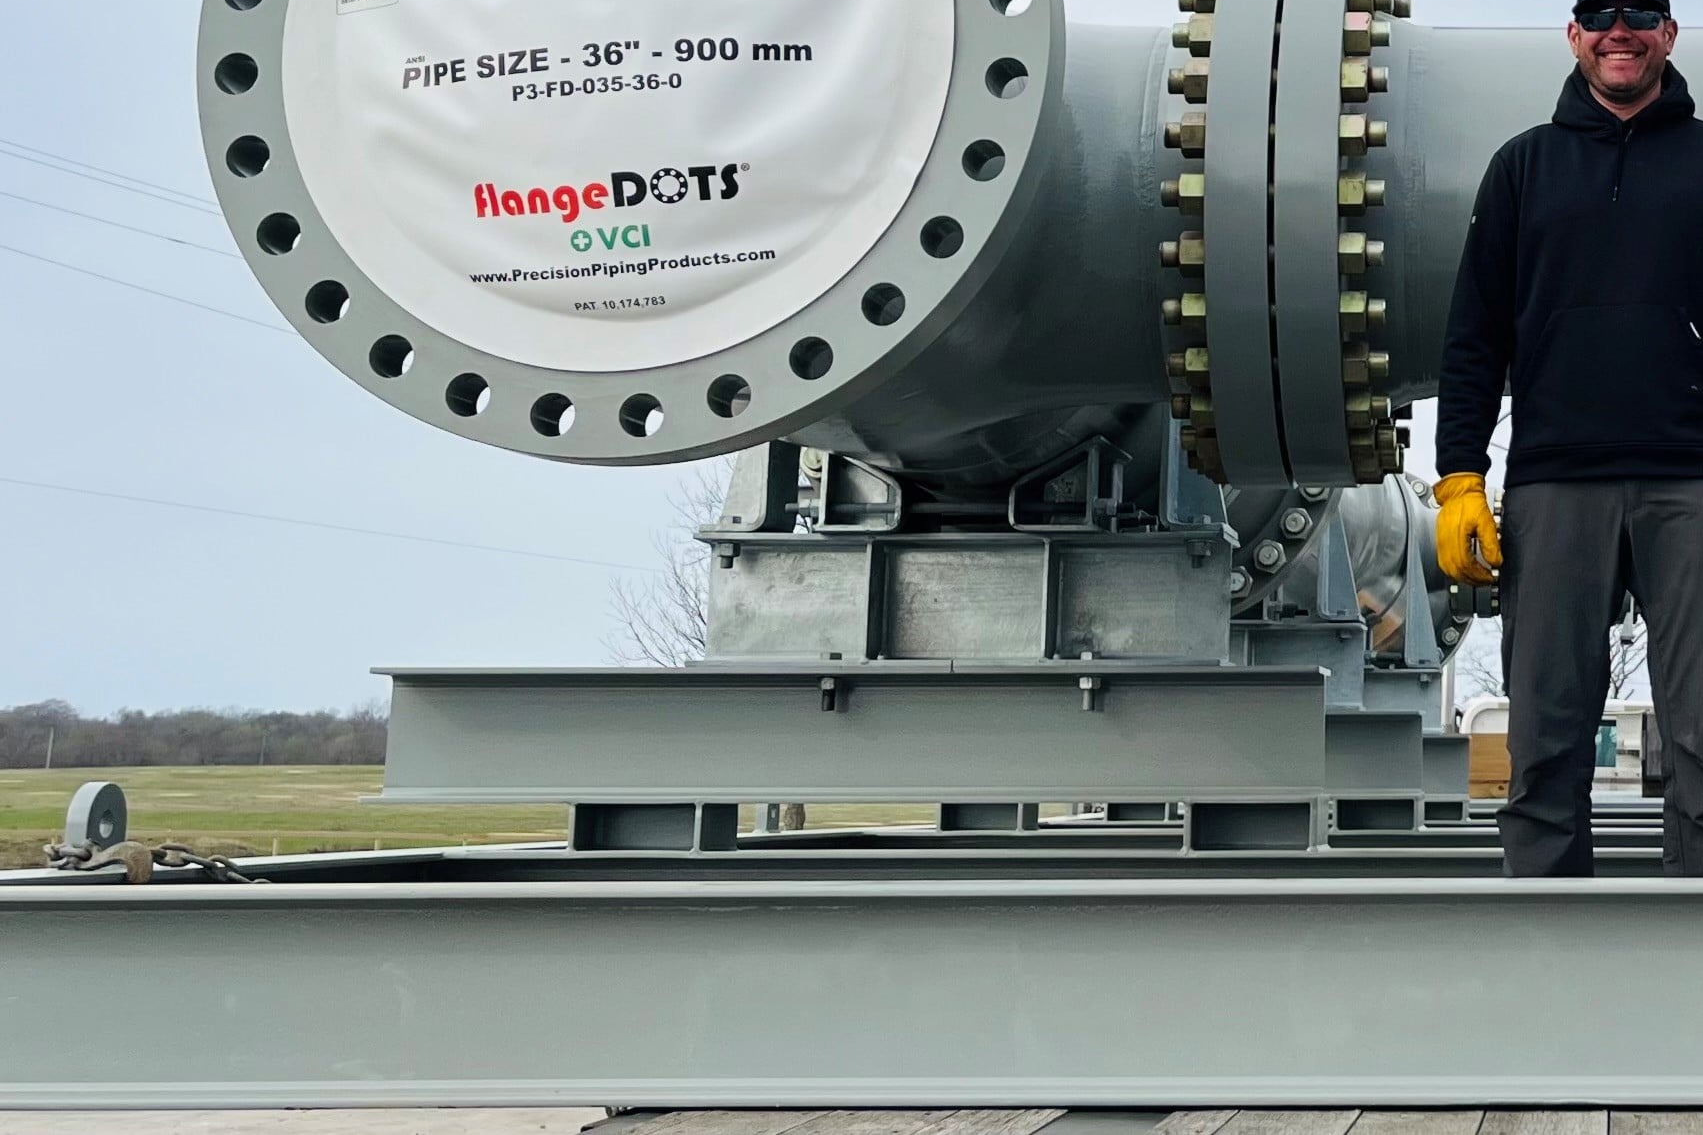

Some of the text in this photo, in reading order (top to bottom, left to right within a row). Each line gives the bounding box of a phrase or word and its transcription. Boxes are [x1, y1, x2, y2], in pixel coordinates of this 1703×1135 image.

[402, 59, 467, 89] PIPE
[476, 47, 549, 78] SIZE
[582, 40, 640, 67] 36"
[674, 37, 740, 62] 900
[752, 43, 813, 61] mm
[405, 55, 426, 64] ANSI
[512, 73, 683, 101] P3-FD-035-36-0
[596, 224, 652, 250] VCI
[469, 248, 776, 283] www.PrecisionPipingProducts.com
[602, 295, 666, 310] 10,174,783
